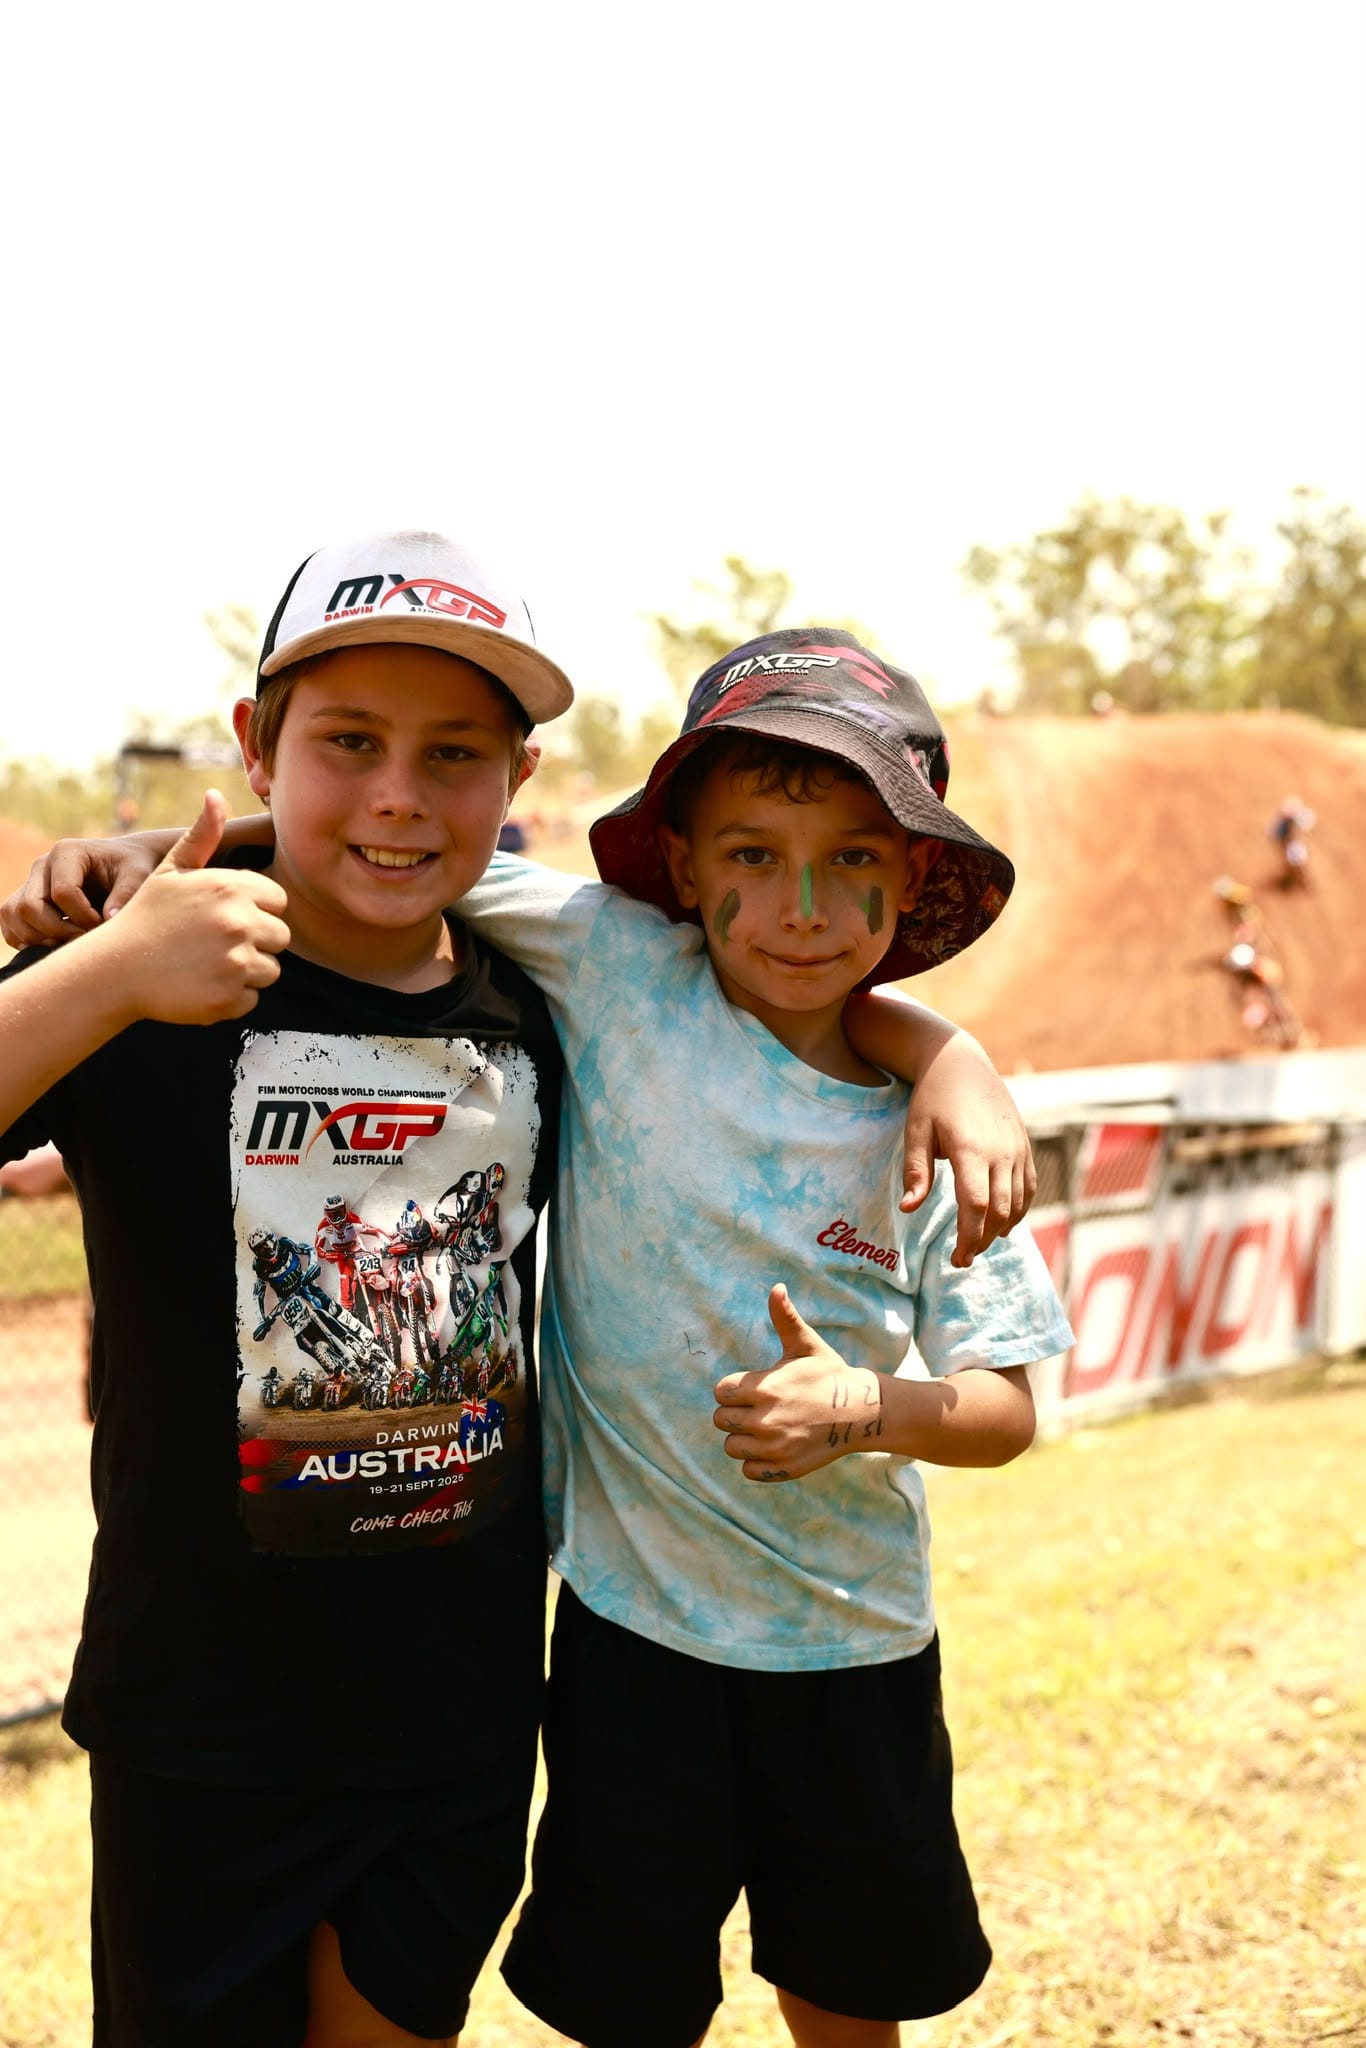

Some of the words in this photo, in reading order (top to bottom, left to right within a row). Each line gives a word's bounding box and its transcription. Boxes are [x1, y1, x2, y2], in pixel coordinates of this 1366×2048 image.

[325, 573, 508, 629] MXGP
[324, 606, 374, 622] DARWIN
[720, 653, 840, 689] MXGP
[763, 668, 810, 676] AUSTRALIA
[257, 1085, 276, 1095] FIM
[278, 1086, 339, 1096] MOTOCROSS
[341, 1087, 375, 1097] WORLD
[378, 1088, 447, 1099] CHAMPIONSHIP
[245, 1100, 448, 1155] MXGP
[245, 1155, 299, 1166] DARWIN
[332, 1155, 404, 1166] AUSTRALIA
[360, 1258, 381, 1271] 243
[376, 1421, 459, 1445] DARWIN
[298, 1427, 504, 1481] AUSTRALIA
[369, 1483, 403, 1495] 19-21
[405, 1479, 434, 1492] SEPT
[437, 1473, 464, 1487] 2025
[350, 1516, 395, 1533] COME
[400, 1507, 450, 1529] CHECK
[452, 1499, 475, 1520] THIS
